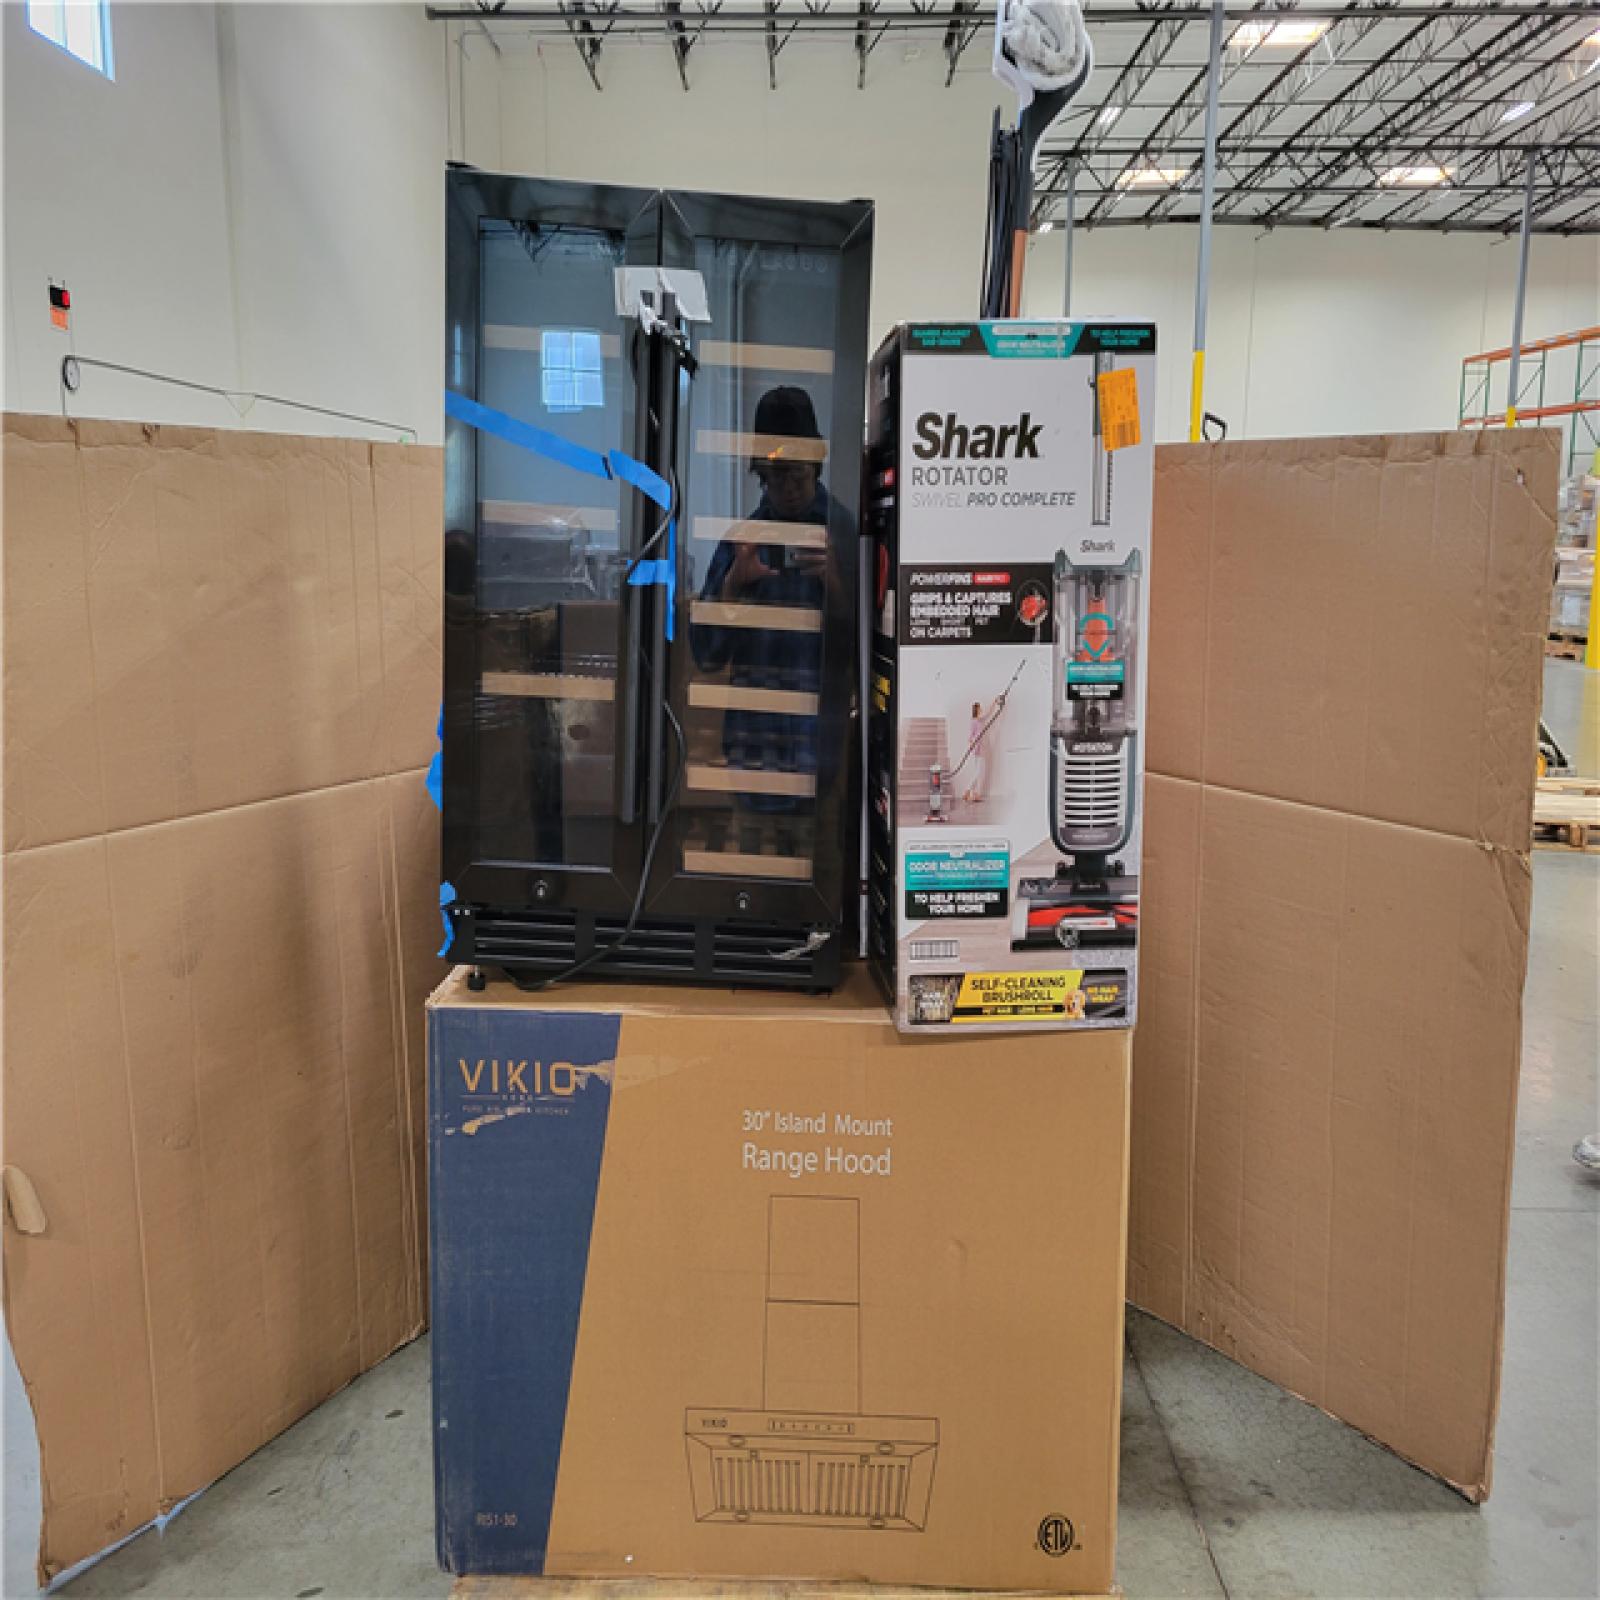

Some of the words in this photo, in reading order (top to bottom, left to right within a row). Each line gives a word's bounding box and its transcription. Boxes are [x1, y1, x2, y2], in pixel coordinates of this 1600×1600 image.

[912, 412, 1044, 460] Shark
[911, 467, 1008, 486] ROTATOR
[911, 493, 963, 508] SWIVEL
[967, 493, 997, 506] PRO
[1001, 492, 1077, 506] COMPLETE
[1080, 539, 1116, 553] Shark
[954, 591, 1011, 604] CAPTURES
[973, 604, 1000, 616] HAIR
[909, 627, 925, 638] ON
[928, 626, 973, 638] CARPETS
[940, 859, 1005, 871] NEUTRALIZER
[914, 894, 928, 904] TO
[929, 893, 954, 904] HELP
[955, 892, 1000, 903] FRESHEN
[929, 904, 955, 915] YOUR
[957, 903, 985, 914] HOME
[971, 976, 1065, 991] SELF-CLEANING
[982, 989, 1054, 1003] BRUSHROLL
[459, 1059, 577, 1096] VIKIO
[742, 1109, 771, 1131] 30"
[774, 1111, 825, 1135] Island
[834, 1114, 893, 1138] Mount
[743, 1142, 818, 1178] Range
[825, 1145, 892, 1176] Hood
